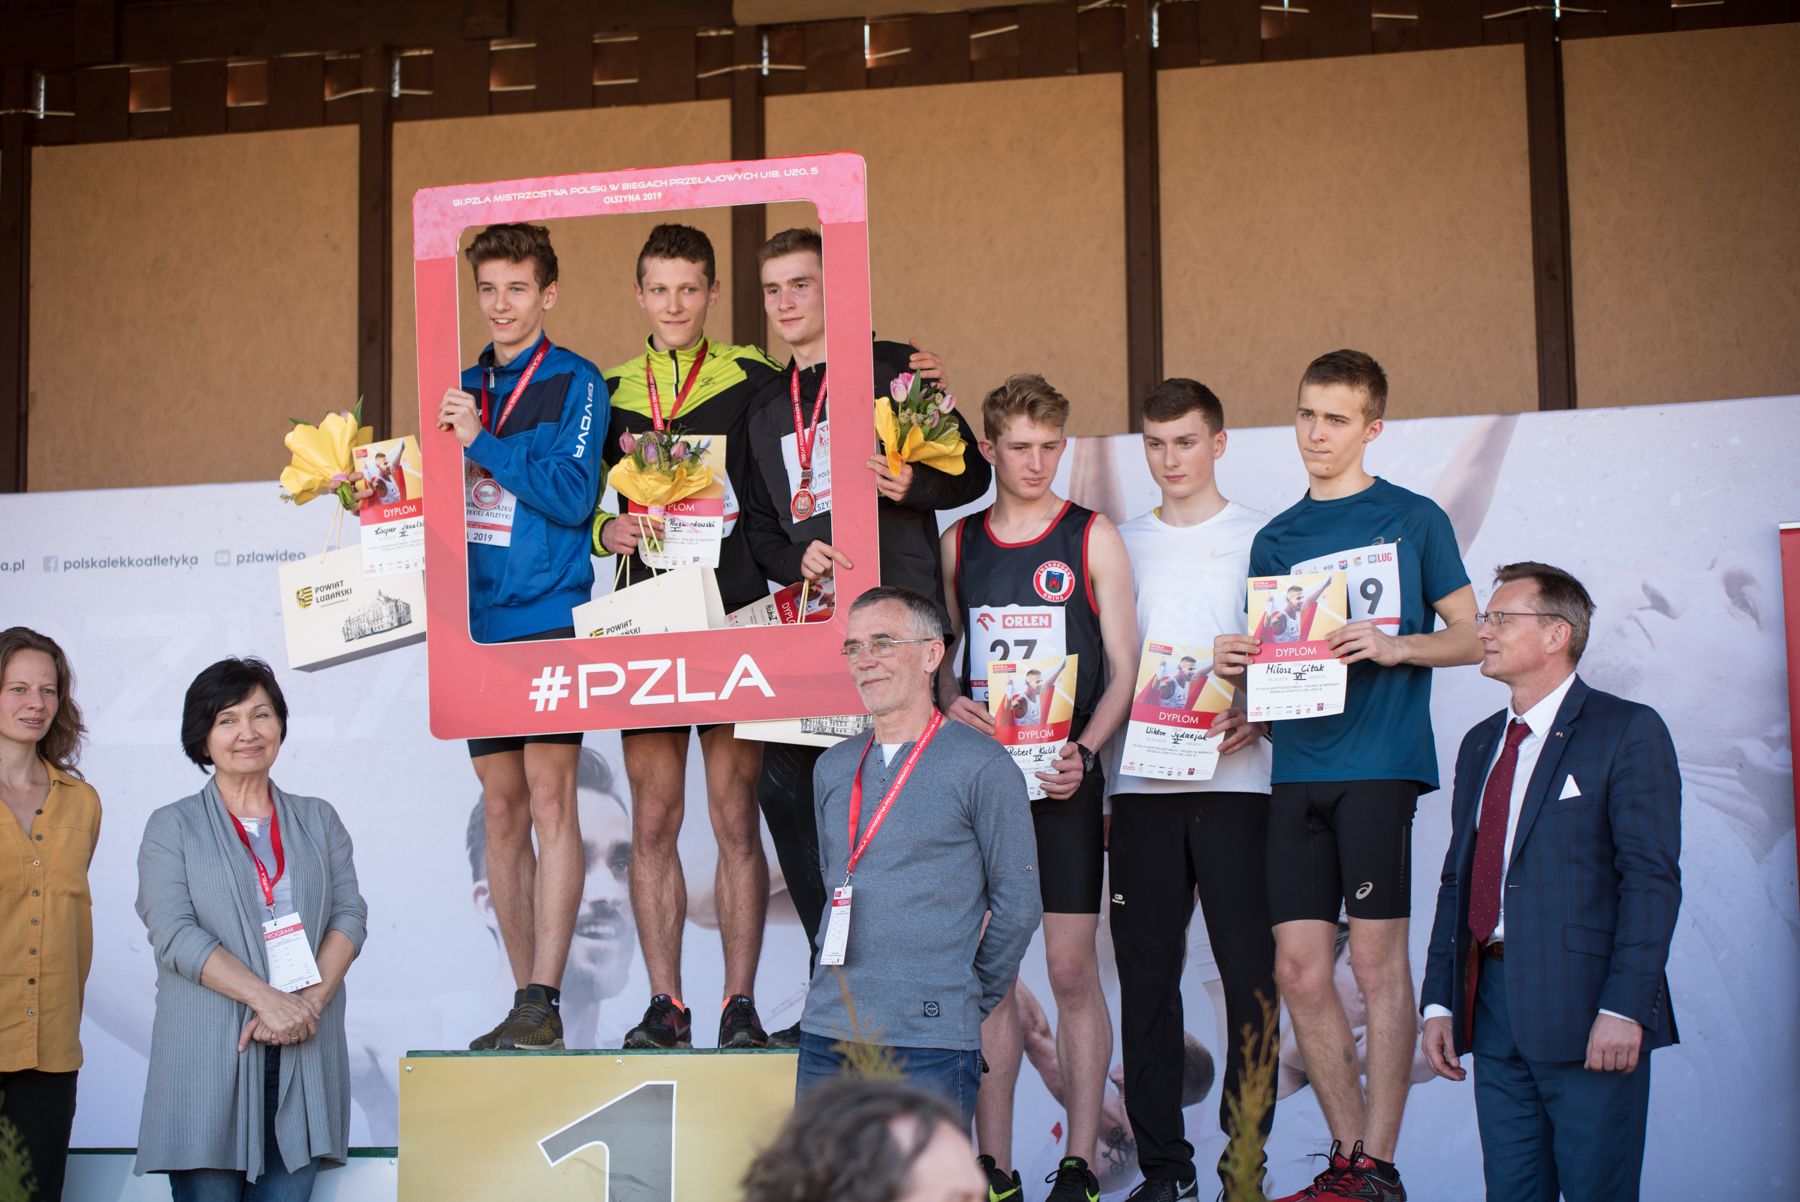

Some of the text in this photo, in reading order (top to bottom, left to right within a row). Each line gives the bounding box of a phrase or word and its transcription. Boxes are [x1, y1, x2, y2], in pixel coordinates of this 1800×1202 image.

[494, 188, 568, 202] MISTRZOSTWA
[570, 184, 606, 195] POLSKI
[609, 183, 620, 191] W
[622, 180, 668, 190] BIEGACH
[670, 172, 758, 186] PRZEŁAJOWYCH
[604, 192, 662, 204] OLSZYNA 2019
[573, 382, 594, 458] GIVOVA
[384, 504, 417, 518] DYPLOM
[668, 503, 695, 511] PLOM
[485, 510, 511, 520] ATLETYKI
[474, 533, 493, 542] 2019
[63, 554, 198, 572] polskalekkoatletyka
[236, 550, 306, 565] pzlawideo
[1377, 552, 1392, 562] LUG
[315, 580, 344, 594] POWIAT
[316, 588, 352, 603] LUBAŃSKI
[1347, 578, 1383, 619] 9
[606, 619, 632, 635] POWIAT
[1004, 616, 1049, 627] ORLEN
[990, 639, 1037, 660] 27
[1276, 647, 1317, 657] DYPLOM
[528, 654, 776, 712] #PZLA
[1158, 712, 1199, 724] DYPLOM
[1018, 729, 1054, 740] DYPLOM
[1007, 746, 1032, 756] Robert
[264, 927, 294, 940] PROGRAM
[537, 1080, 677, 1202] 1
